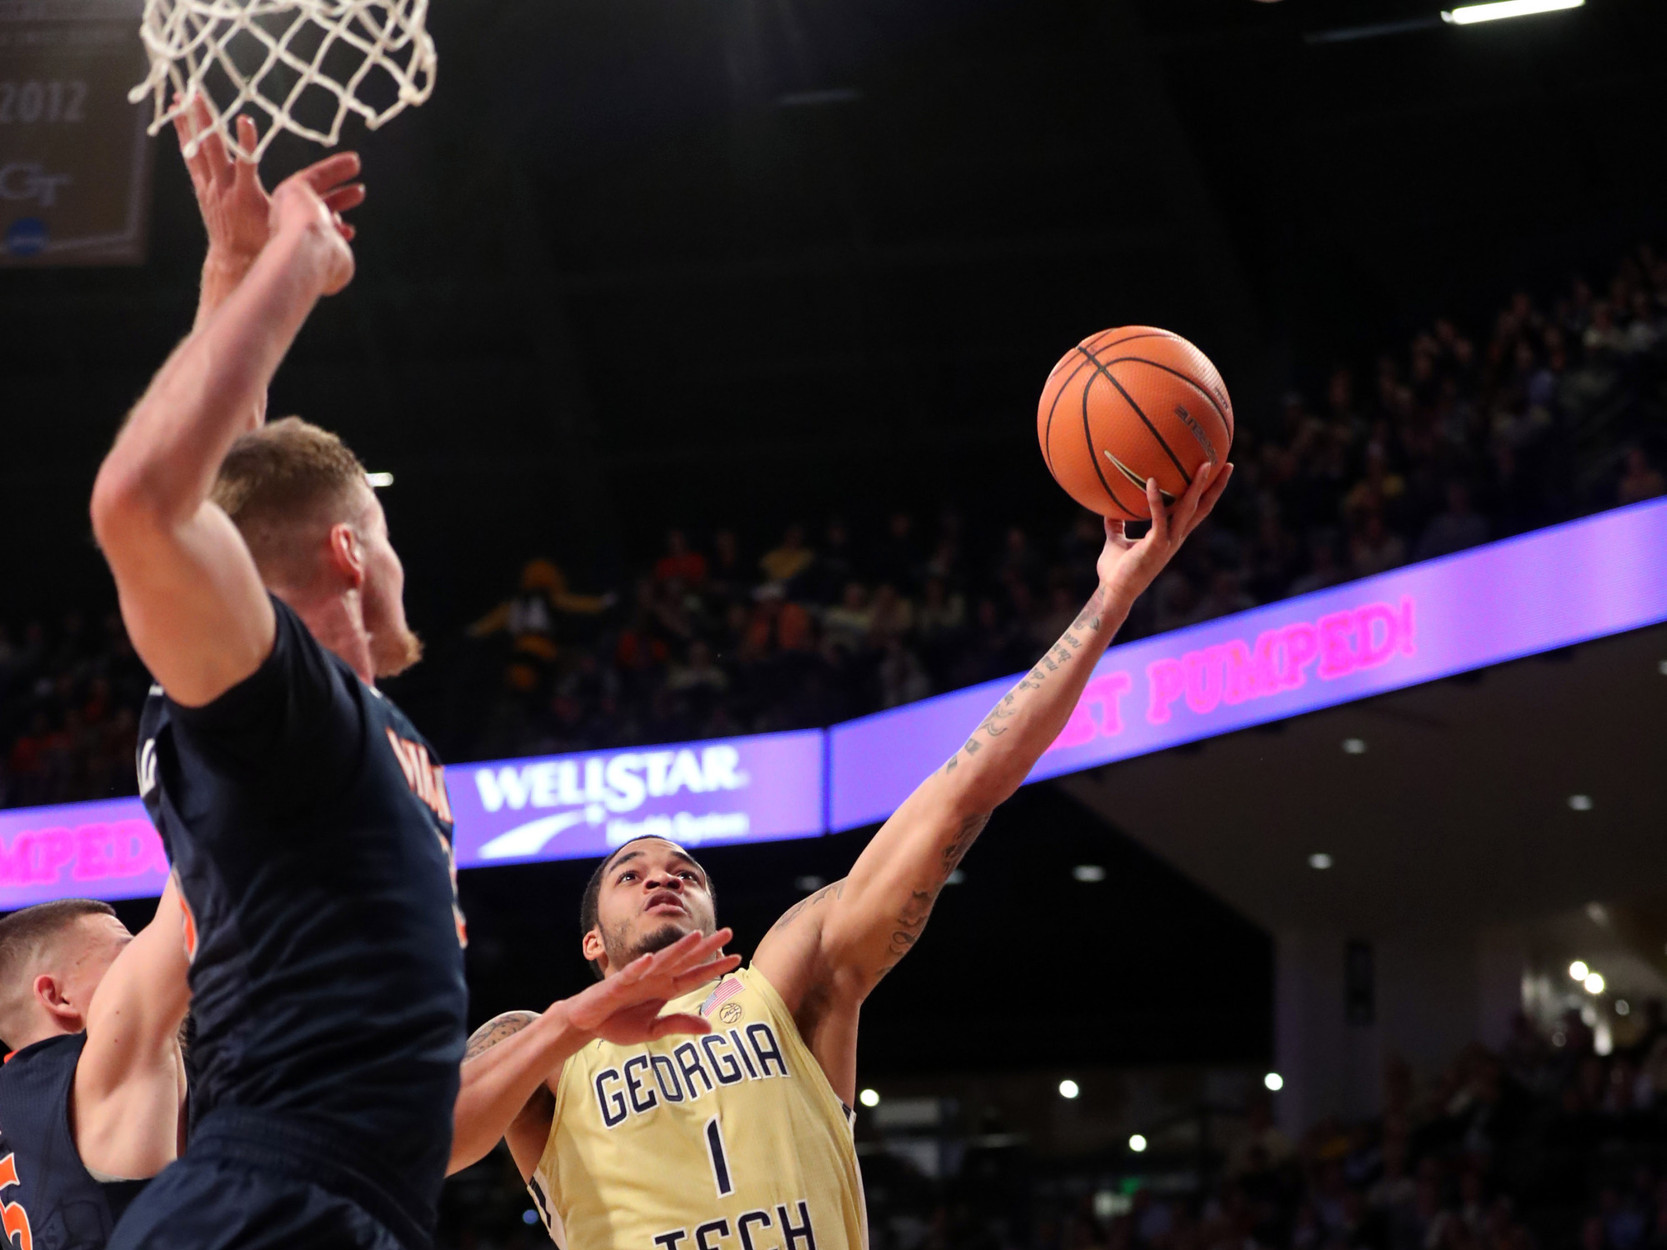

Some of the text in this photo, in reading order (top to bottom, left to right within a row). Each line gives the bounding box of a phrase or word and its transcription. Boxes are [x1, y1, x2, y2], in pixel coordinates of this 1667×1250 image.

[1146, 598, 1416, 726] PUMPED!
[475, 744, 742, 814] WELLSTAR
[593, 1022, 791, 1130] GEORGIA
[703, 1113, 735, 1199] 1
